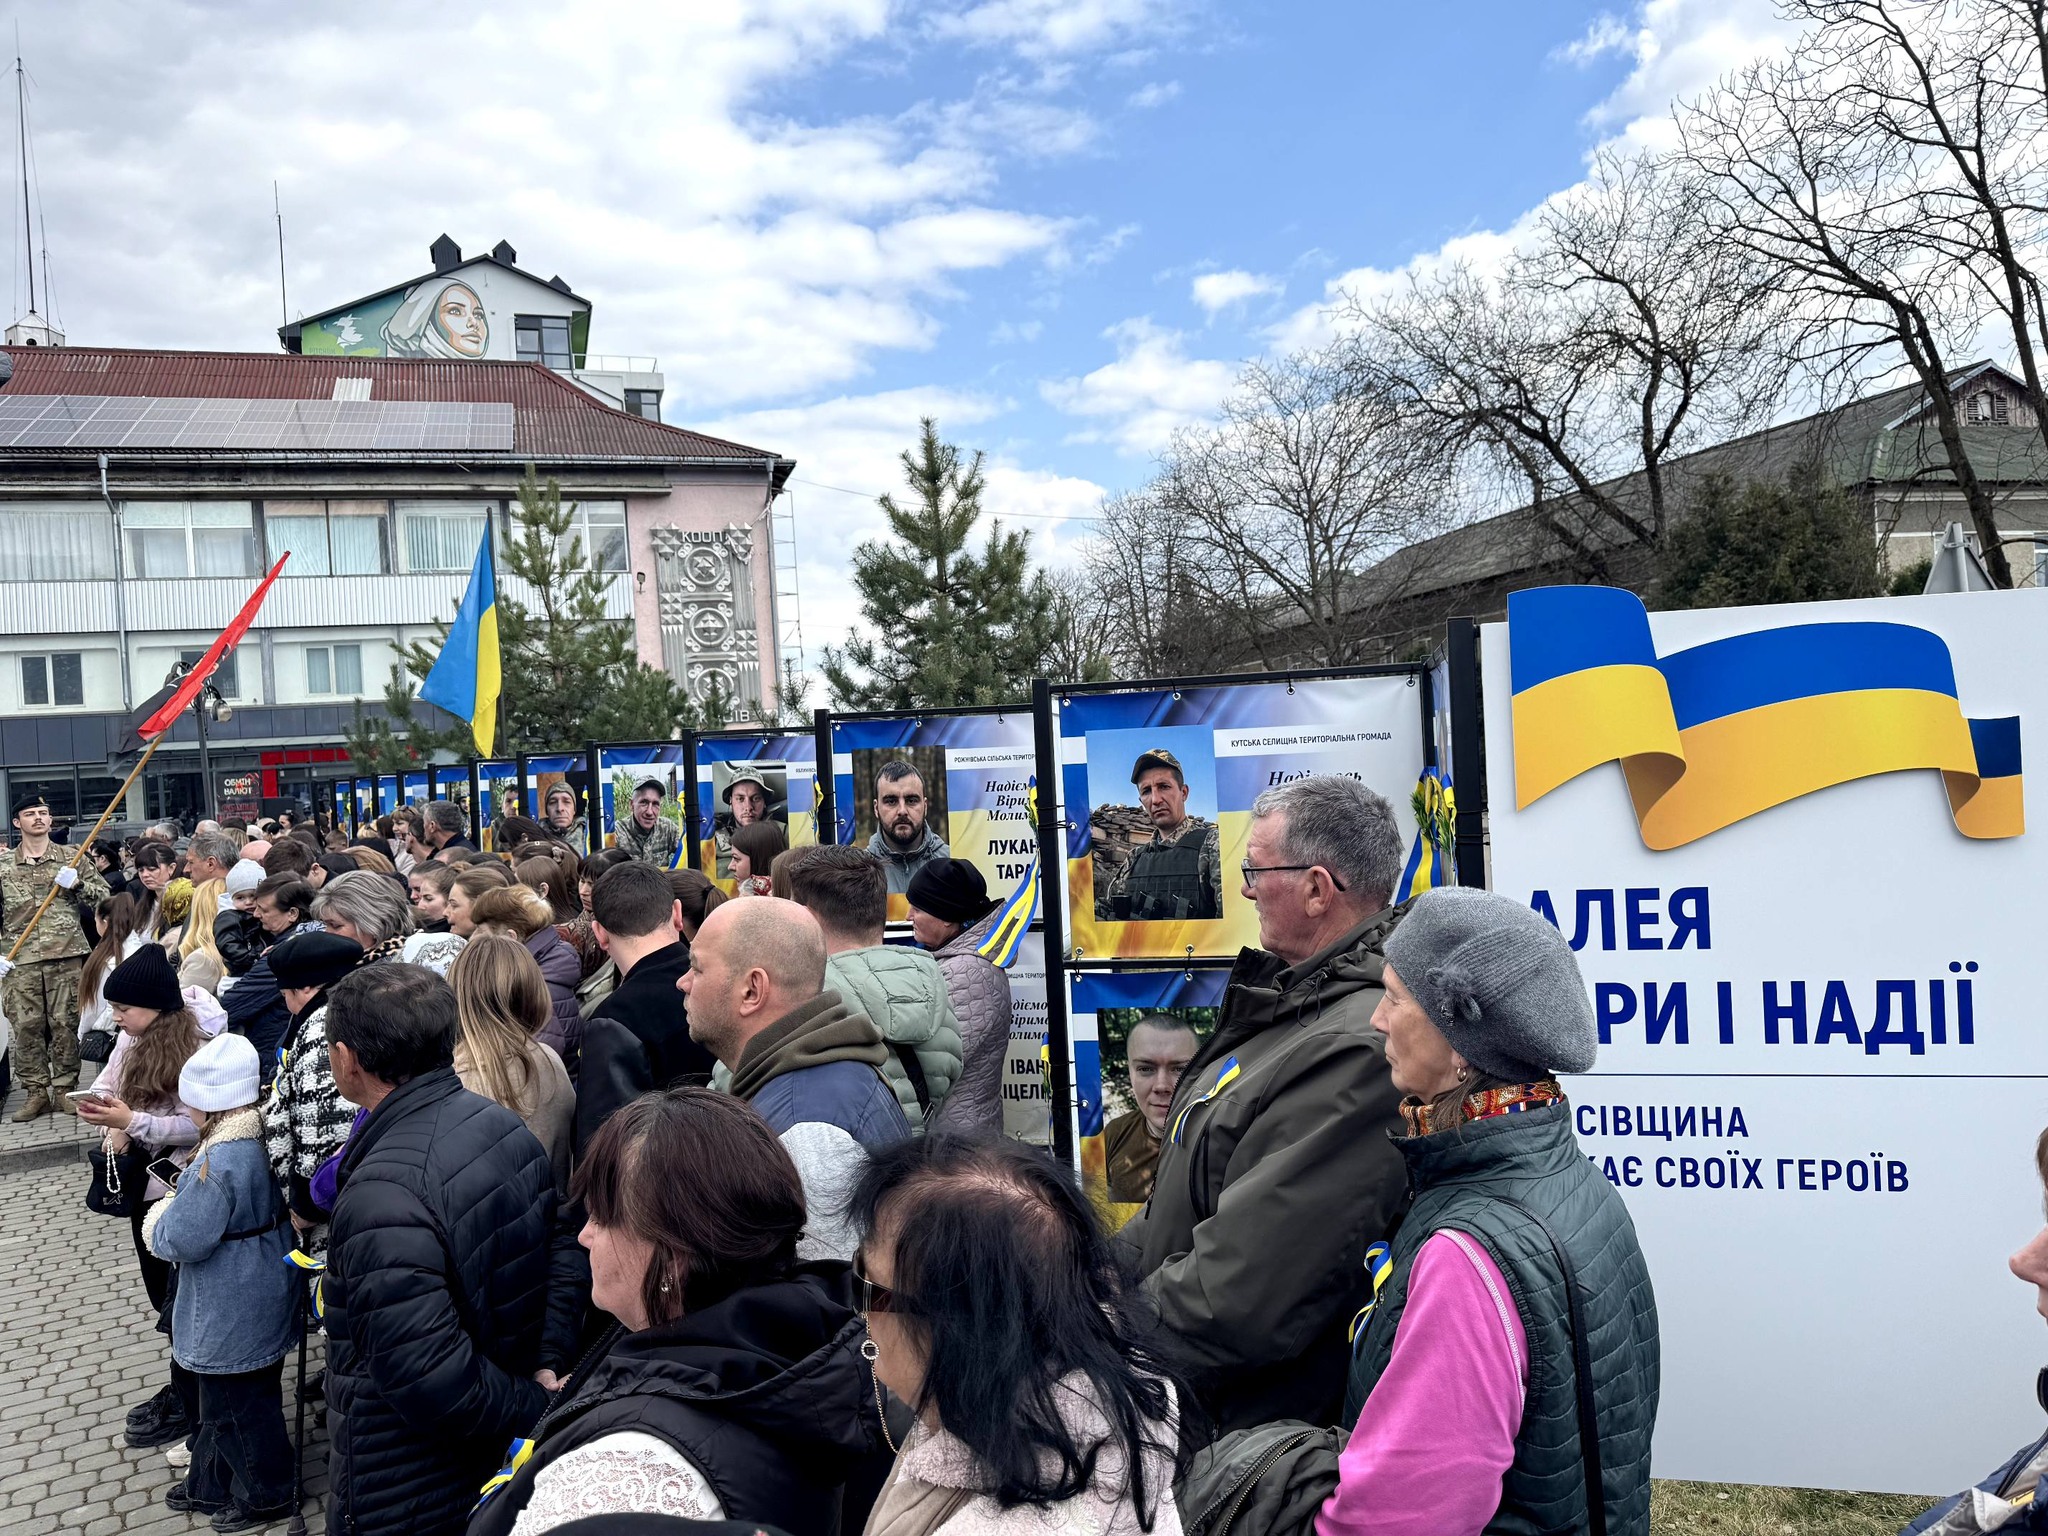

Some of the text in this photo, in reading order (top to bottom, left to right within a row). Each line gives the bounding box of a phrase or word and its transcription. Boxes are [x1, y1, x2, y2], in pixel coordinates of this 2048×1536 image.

[699, 709, 750, 723] КСІВ
[1231, 732, 1392, 748] КУТСЬКА СЕЛИЩНА ТЕРИТОРІАЛЬНА ГРОМАДА
[1012, 753, 1035, 761] ТЕРИТОР
[996, 795, 1029, 809] Віри
[1012, 998, 1048, 1011] діємо
[1595, 961, 1980, 1056] РИ І НАДІЇ
[1576, 1104, 1749, 1142] СІВЩИНА
[1588, 1149, 1910, 1193] АЄ СВОЇХ ГЕРОЇВ
